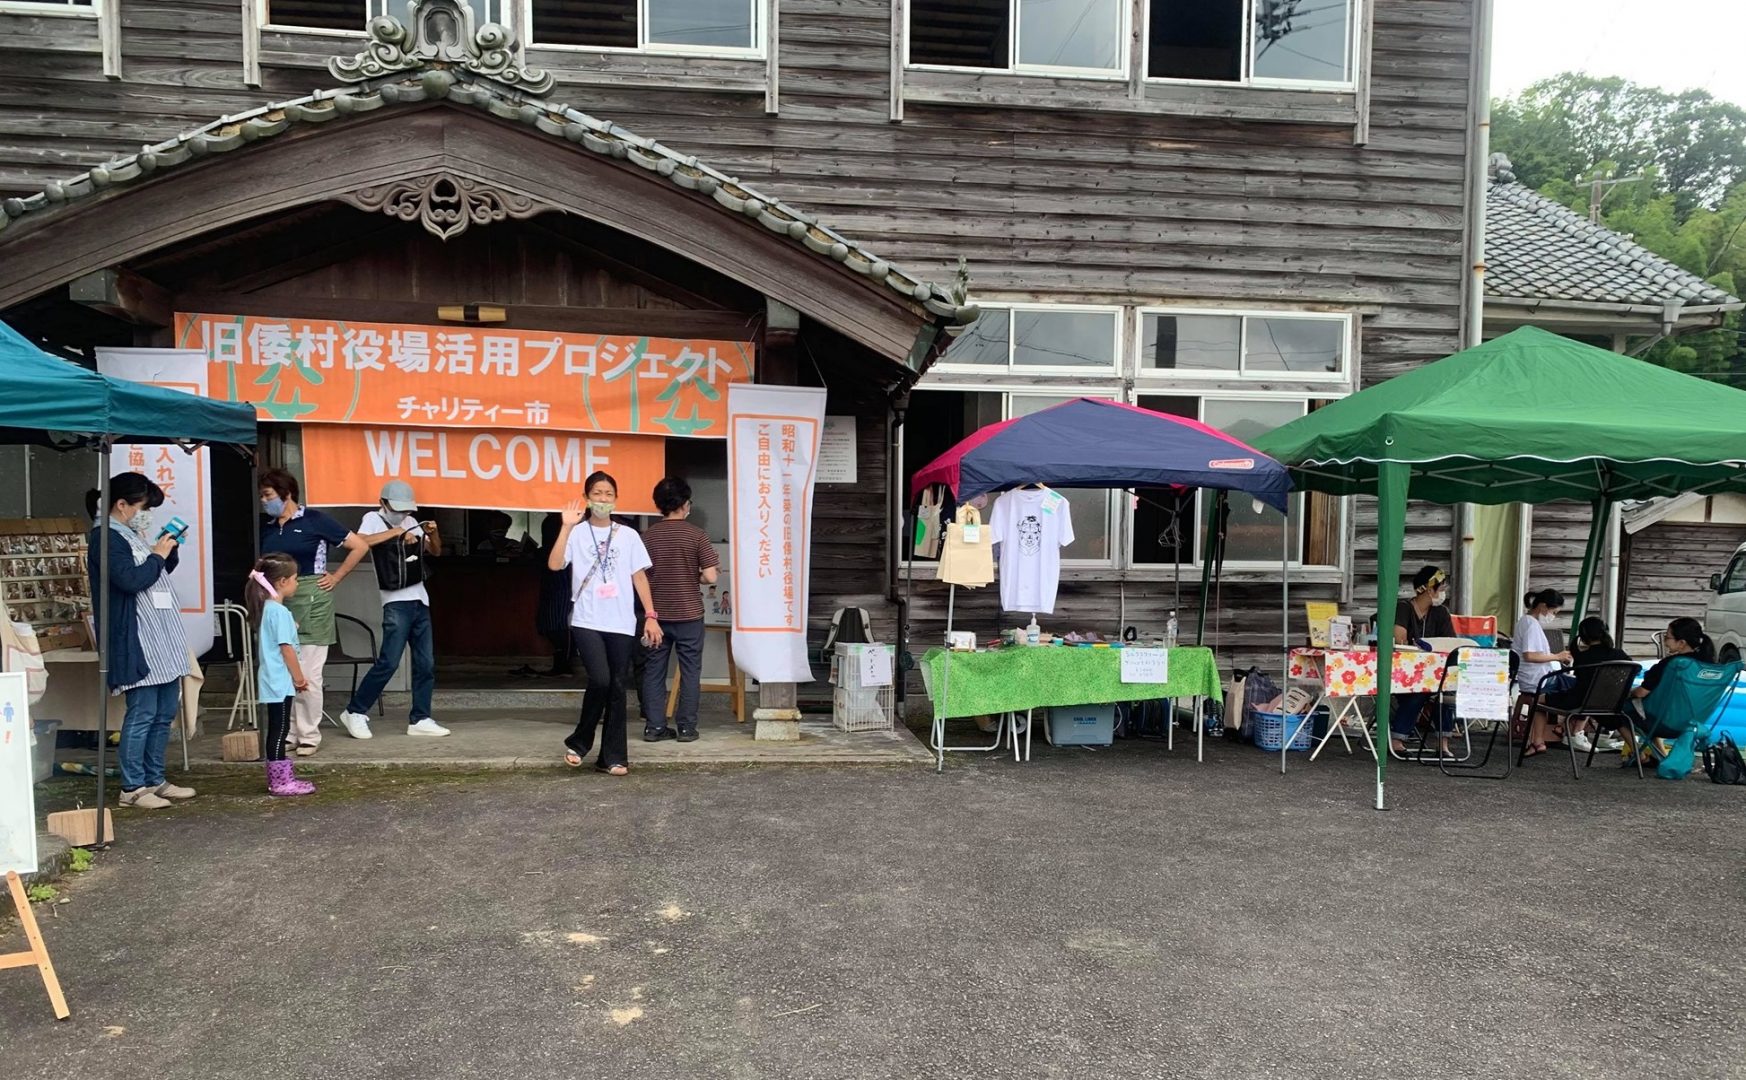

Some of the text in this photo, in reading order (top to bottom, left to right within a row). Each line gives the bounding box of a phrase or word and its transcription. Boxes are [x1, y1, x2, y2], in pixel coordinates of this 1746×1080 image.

[201, 320, 733, 384] 旧倭村役場活用プロジェクト
[396, 394, 551, 425] チャリティー市
[363, 430, 612, 483] WELCOME
[758, 423, 772, 578] ご自由にお入りください
